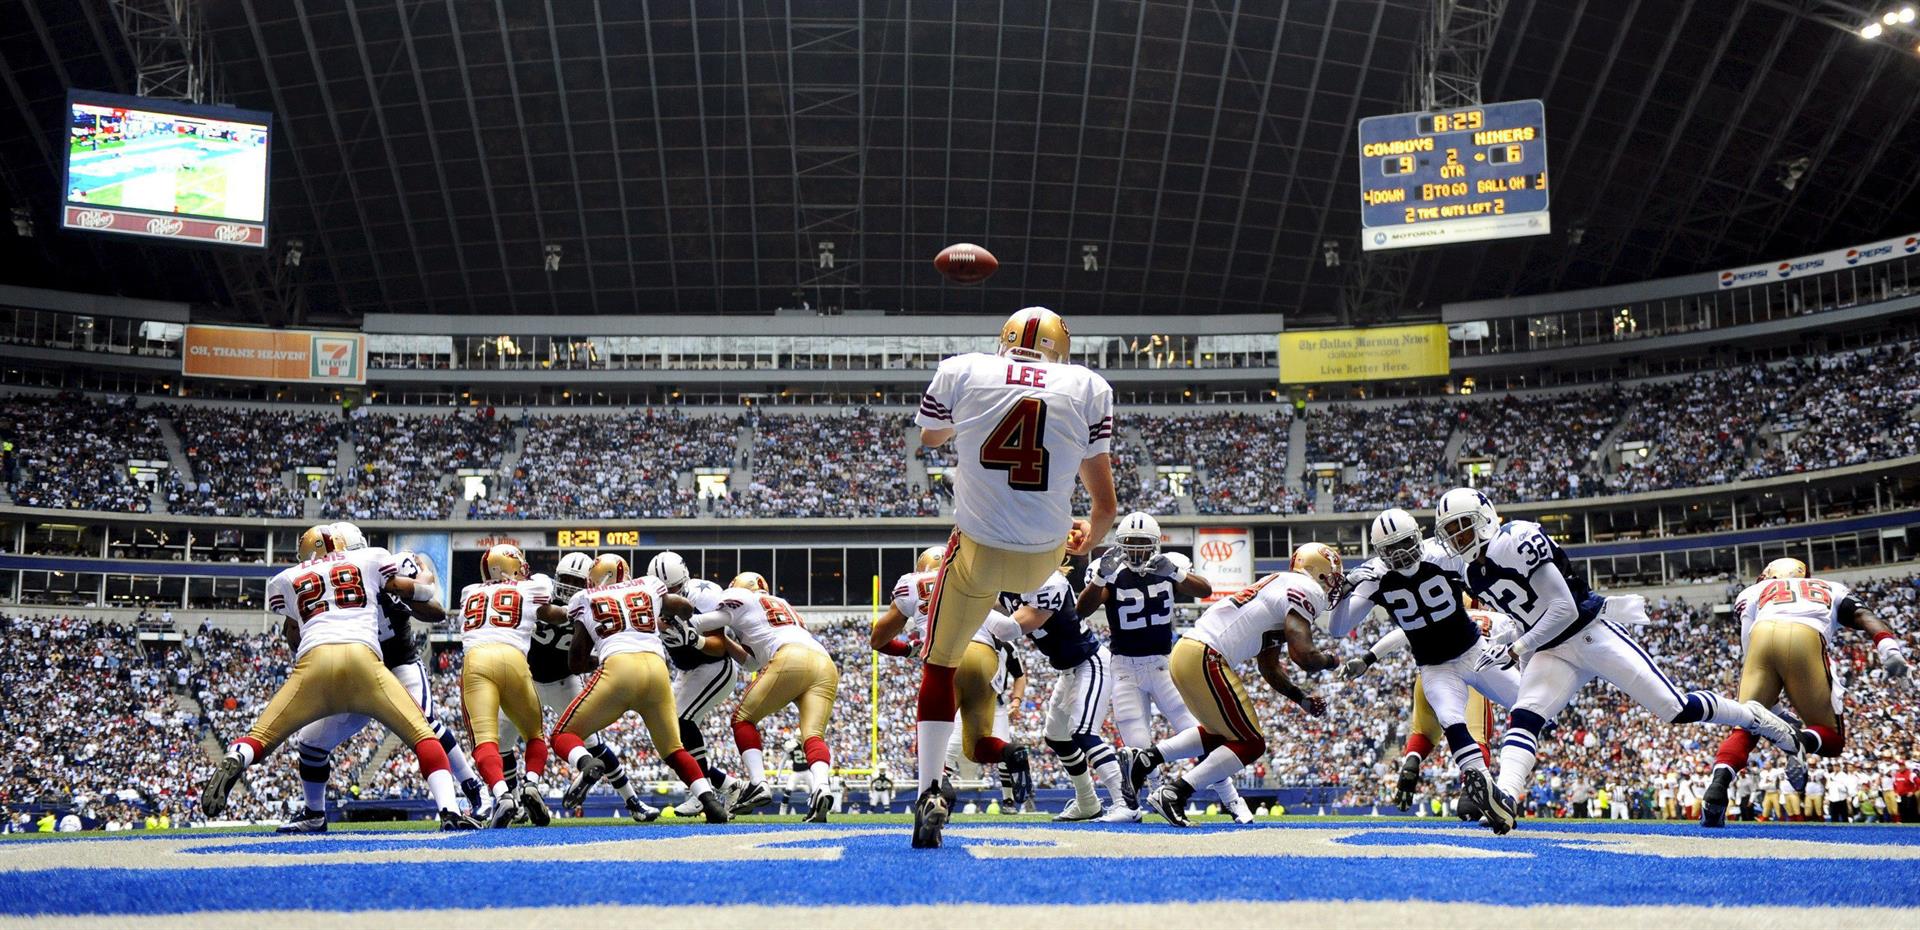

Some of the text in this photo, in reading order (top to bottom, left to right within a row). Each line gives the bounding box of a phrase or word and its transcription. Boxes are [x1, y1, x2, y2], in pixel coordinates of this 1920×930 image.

[1364, 137, 1434, 157] COWBOYS
[1506, 145, 1521, 162] 6
[1400, 156, 1413, 173] 9
[1446, 148, 1457, 165] 2
[1477, 178, 1508, 193] BALL
[1405, 207, 1416, 223] 2
[1441, 204, 1465, 218] OUTS
[1467, 202, 1492, 215] LEFT
[1494, 198, 1504, 214] 2
[77, 212, 114, 228] Pepper
[147, 219, 183, 236] Pepper
[215, 226, 249, 243] Pepper
[1858, 246, 1893, 259] PEPSI
[1790, 259, 1824, 272] PEPSI
[1734, 270, 1768, 281] PEPSI
[1319, 338, 1352, 350] Dallas
[1356, 336, 1399, 349] Morning
[1402, 334, 1430, 345] News
[212, 347, 256, 359] THANK
[258, 350, 306, 361] HEAVEN!
[1006, 364, 1048, 388] LEE
[1321, 365, 1342, 375] Live
[1347, 364, 1378, 374] Better
[980, 396, 1050, 492] 4
[558, 530, 600, 546] 8:29
[1517, 534, 1548, 566] 32
[1218, 566, 1242, 574] Texas
[293, 563, 368, 623] 28
[1037, 591, 1062, 610] 54
[1758, 580, 1832, 610] 46
[464, 588, 523, 632] 99
[1117, 580, 1174, 630] 23
[1383, 574, 1456, 631] 29
[592, 592, 656, 638] 98
